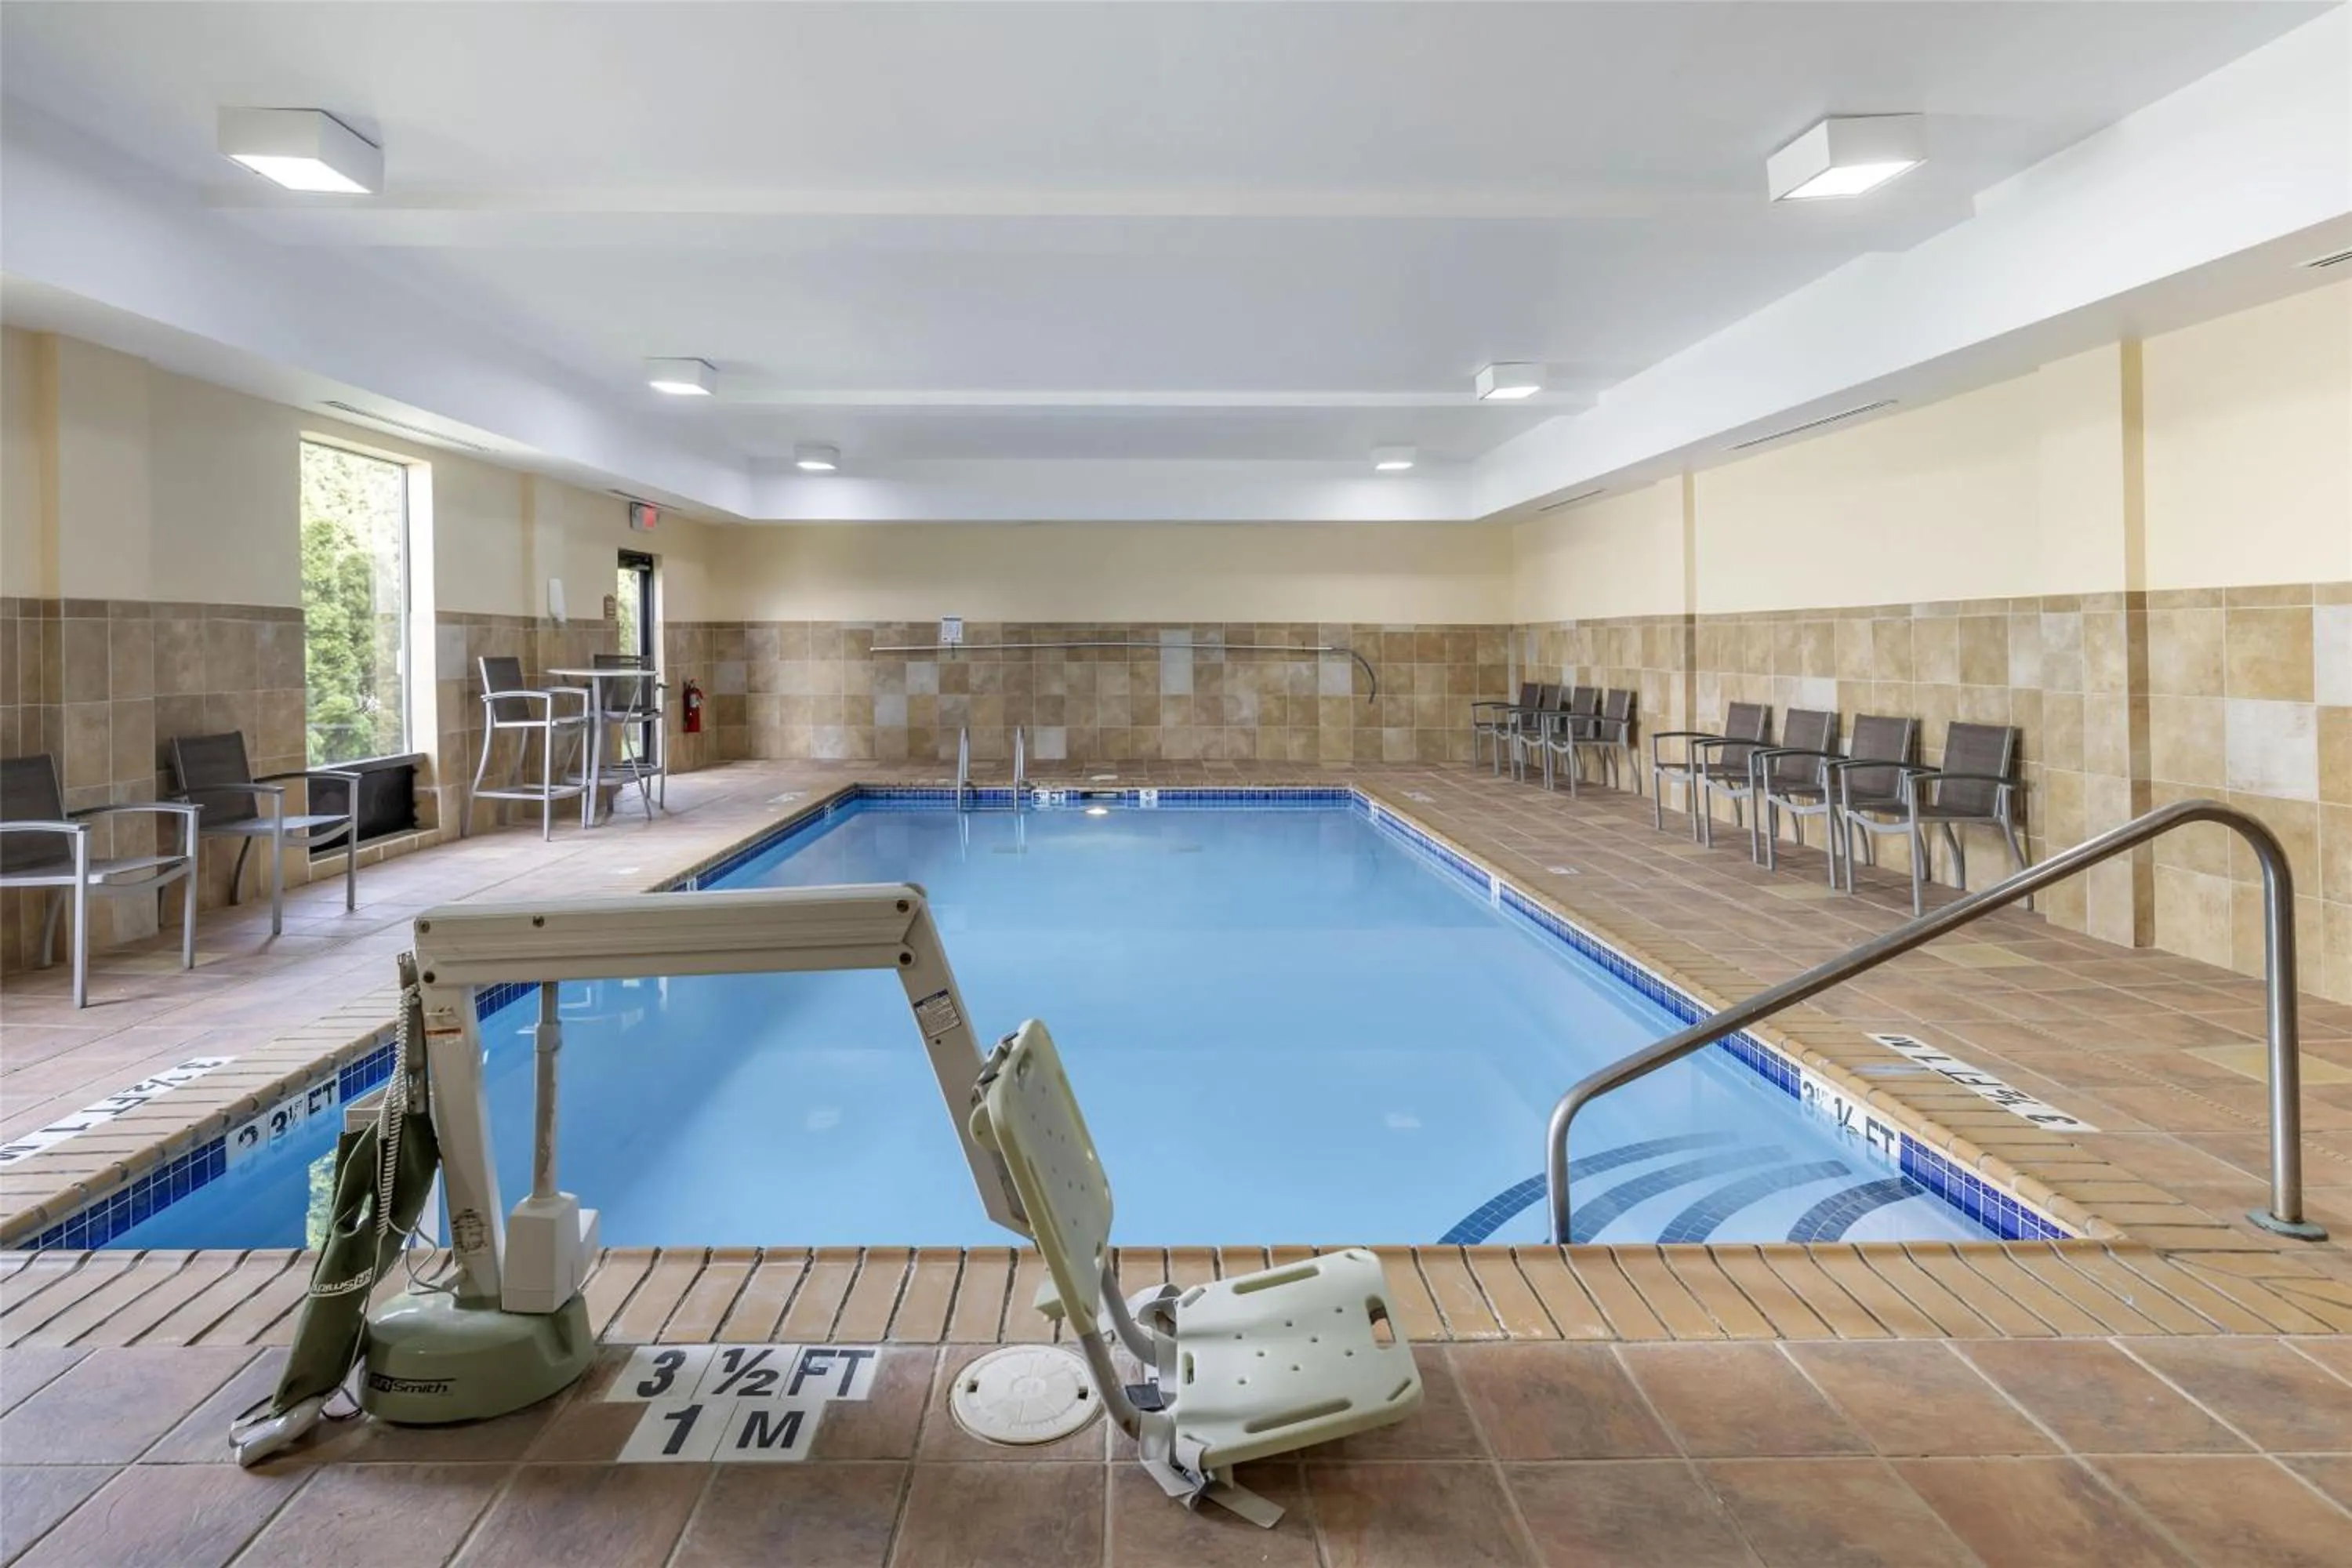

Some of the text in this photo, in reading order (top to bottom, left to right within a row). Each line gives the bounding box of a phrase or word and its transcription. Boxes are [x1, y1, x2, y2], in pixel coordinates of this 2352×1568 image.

[393, 1381, 448, 1394] Smith
[637, 1349, 687, 1398] 3
[786, 1348, 876, 1397] FT
[662, 1404, 805, 1455] 1 M
